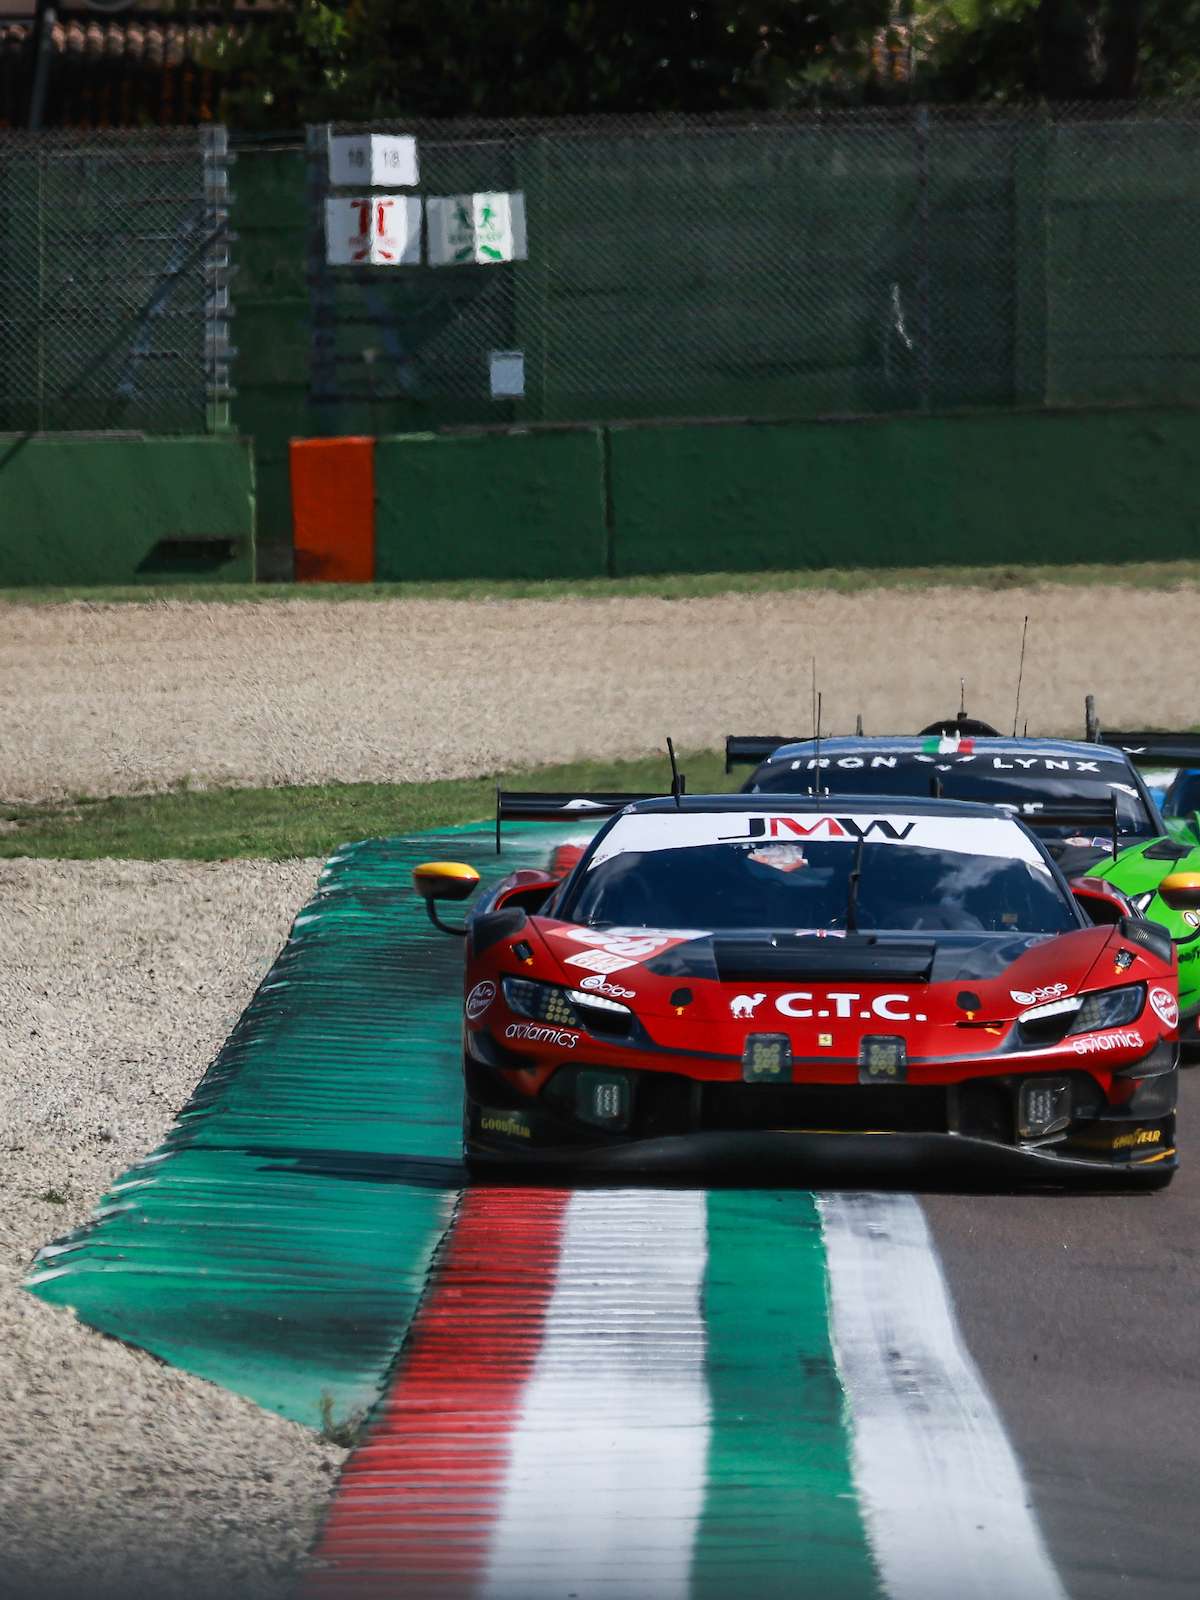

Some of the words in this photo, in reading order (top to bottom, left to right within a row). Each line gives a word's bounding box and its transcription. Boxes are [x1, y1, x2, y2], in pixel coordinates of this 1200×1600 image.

[791, 755, 898, 770] IRON
[993, 757, 1100, 773] LYNX
[717, 817, 918, 840] JMW
[775, 992, 928, 1021] C.T.C.
[505, 1022, 579, 1048] aviamics
[1072, 1029, 1144, 1055] aviamics
[481, 1118, 531, 1138] GOODYEAR
